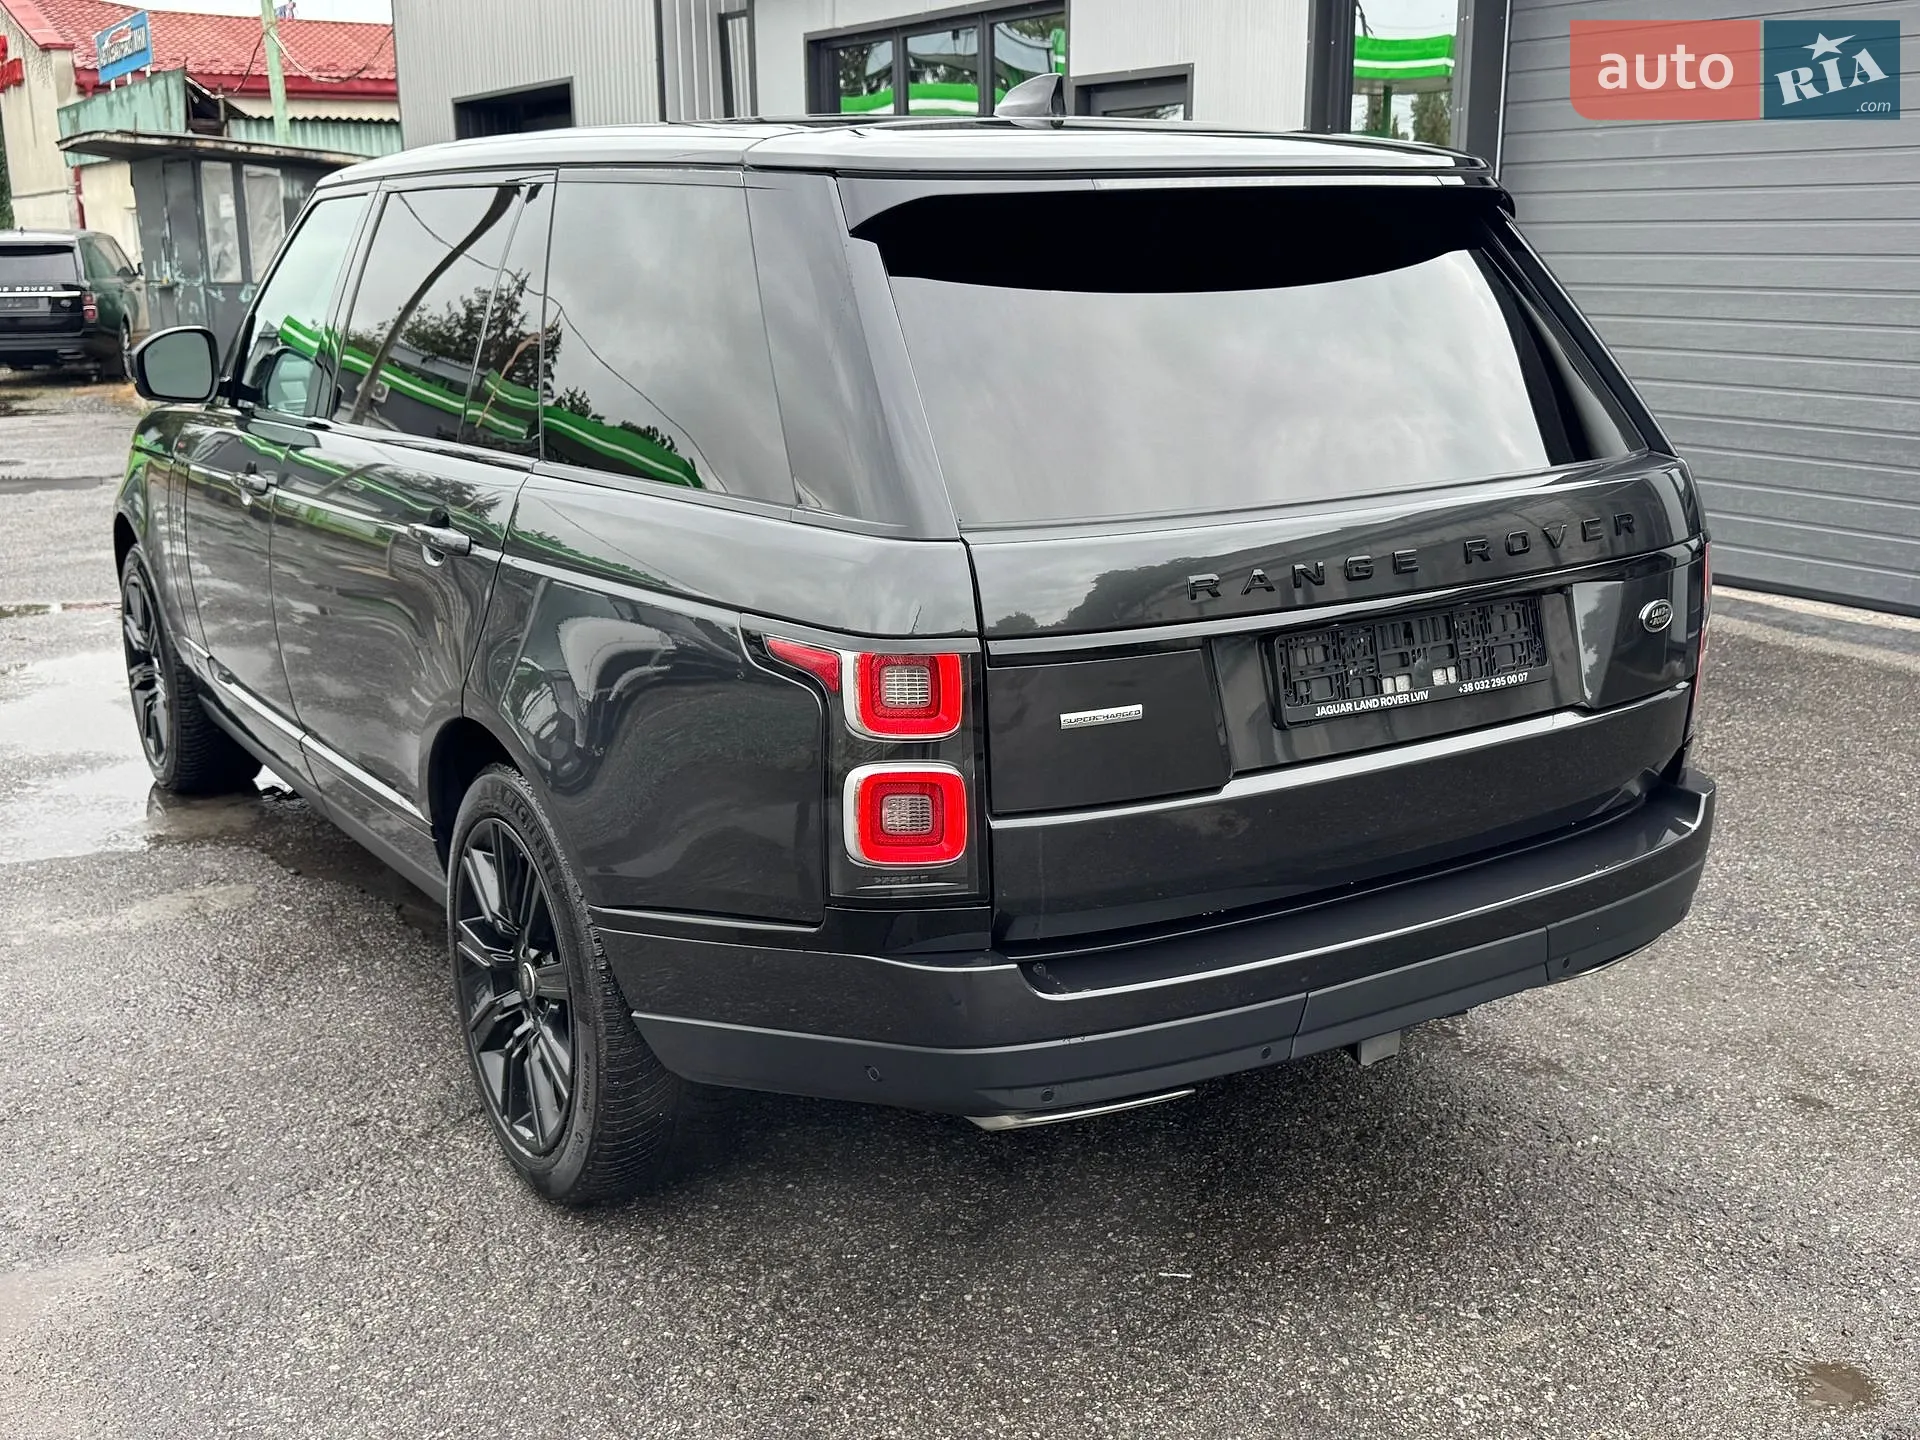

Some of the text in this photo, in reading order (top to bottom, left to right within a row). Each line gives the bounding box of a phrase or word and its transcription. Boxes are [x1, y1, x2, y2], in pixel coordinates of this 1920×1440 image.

[1186, 512, 1635, 600] RANGE ROVER
[1459, 672, 1528, 693] +38 032 295 00 07
[1315, 690, 1429, 717] JAGUAR LAND ROVER LVIV
[1062, 709, 1141, 724] SUPERCHARGED
